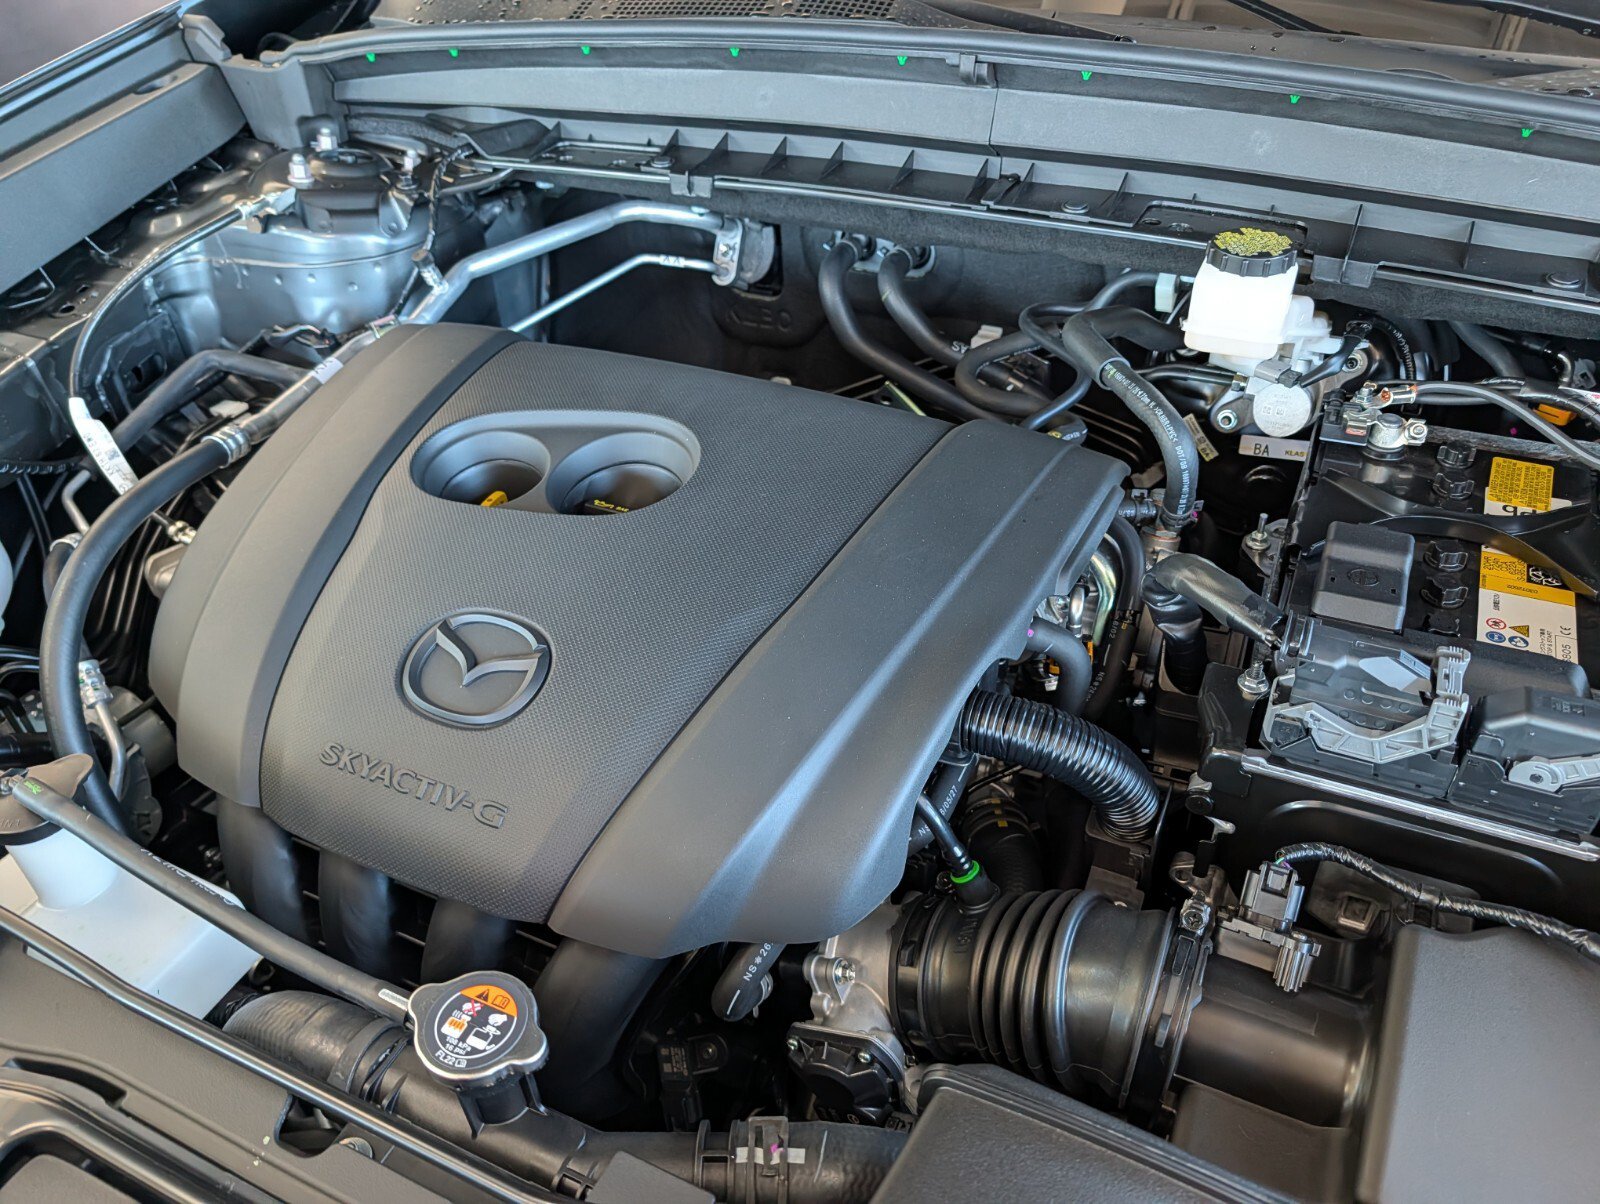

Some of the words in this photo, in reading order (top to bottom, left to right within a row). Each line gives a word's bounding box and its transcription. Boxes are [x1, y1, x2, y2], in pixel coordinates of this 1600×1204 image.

[1253, 443, 1270, 456] BA
[319, 742, 508, 830] SKYACTIV-G
[435, 1049, 455, 1065] FL22
